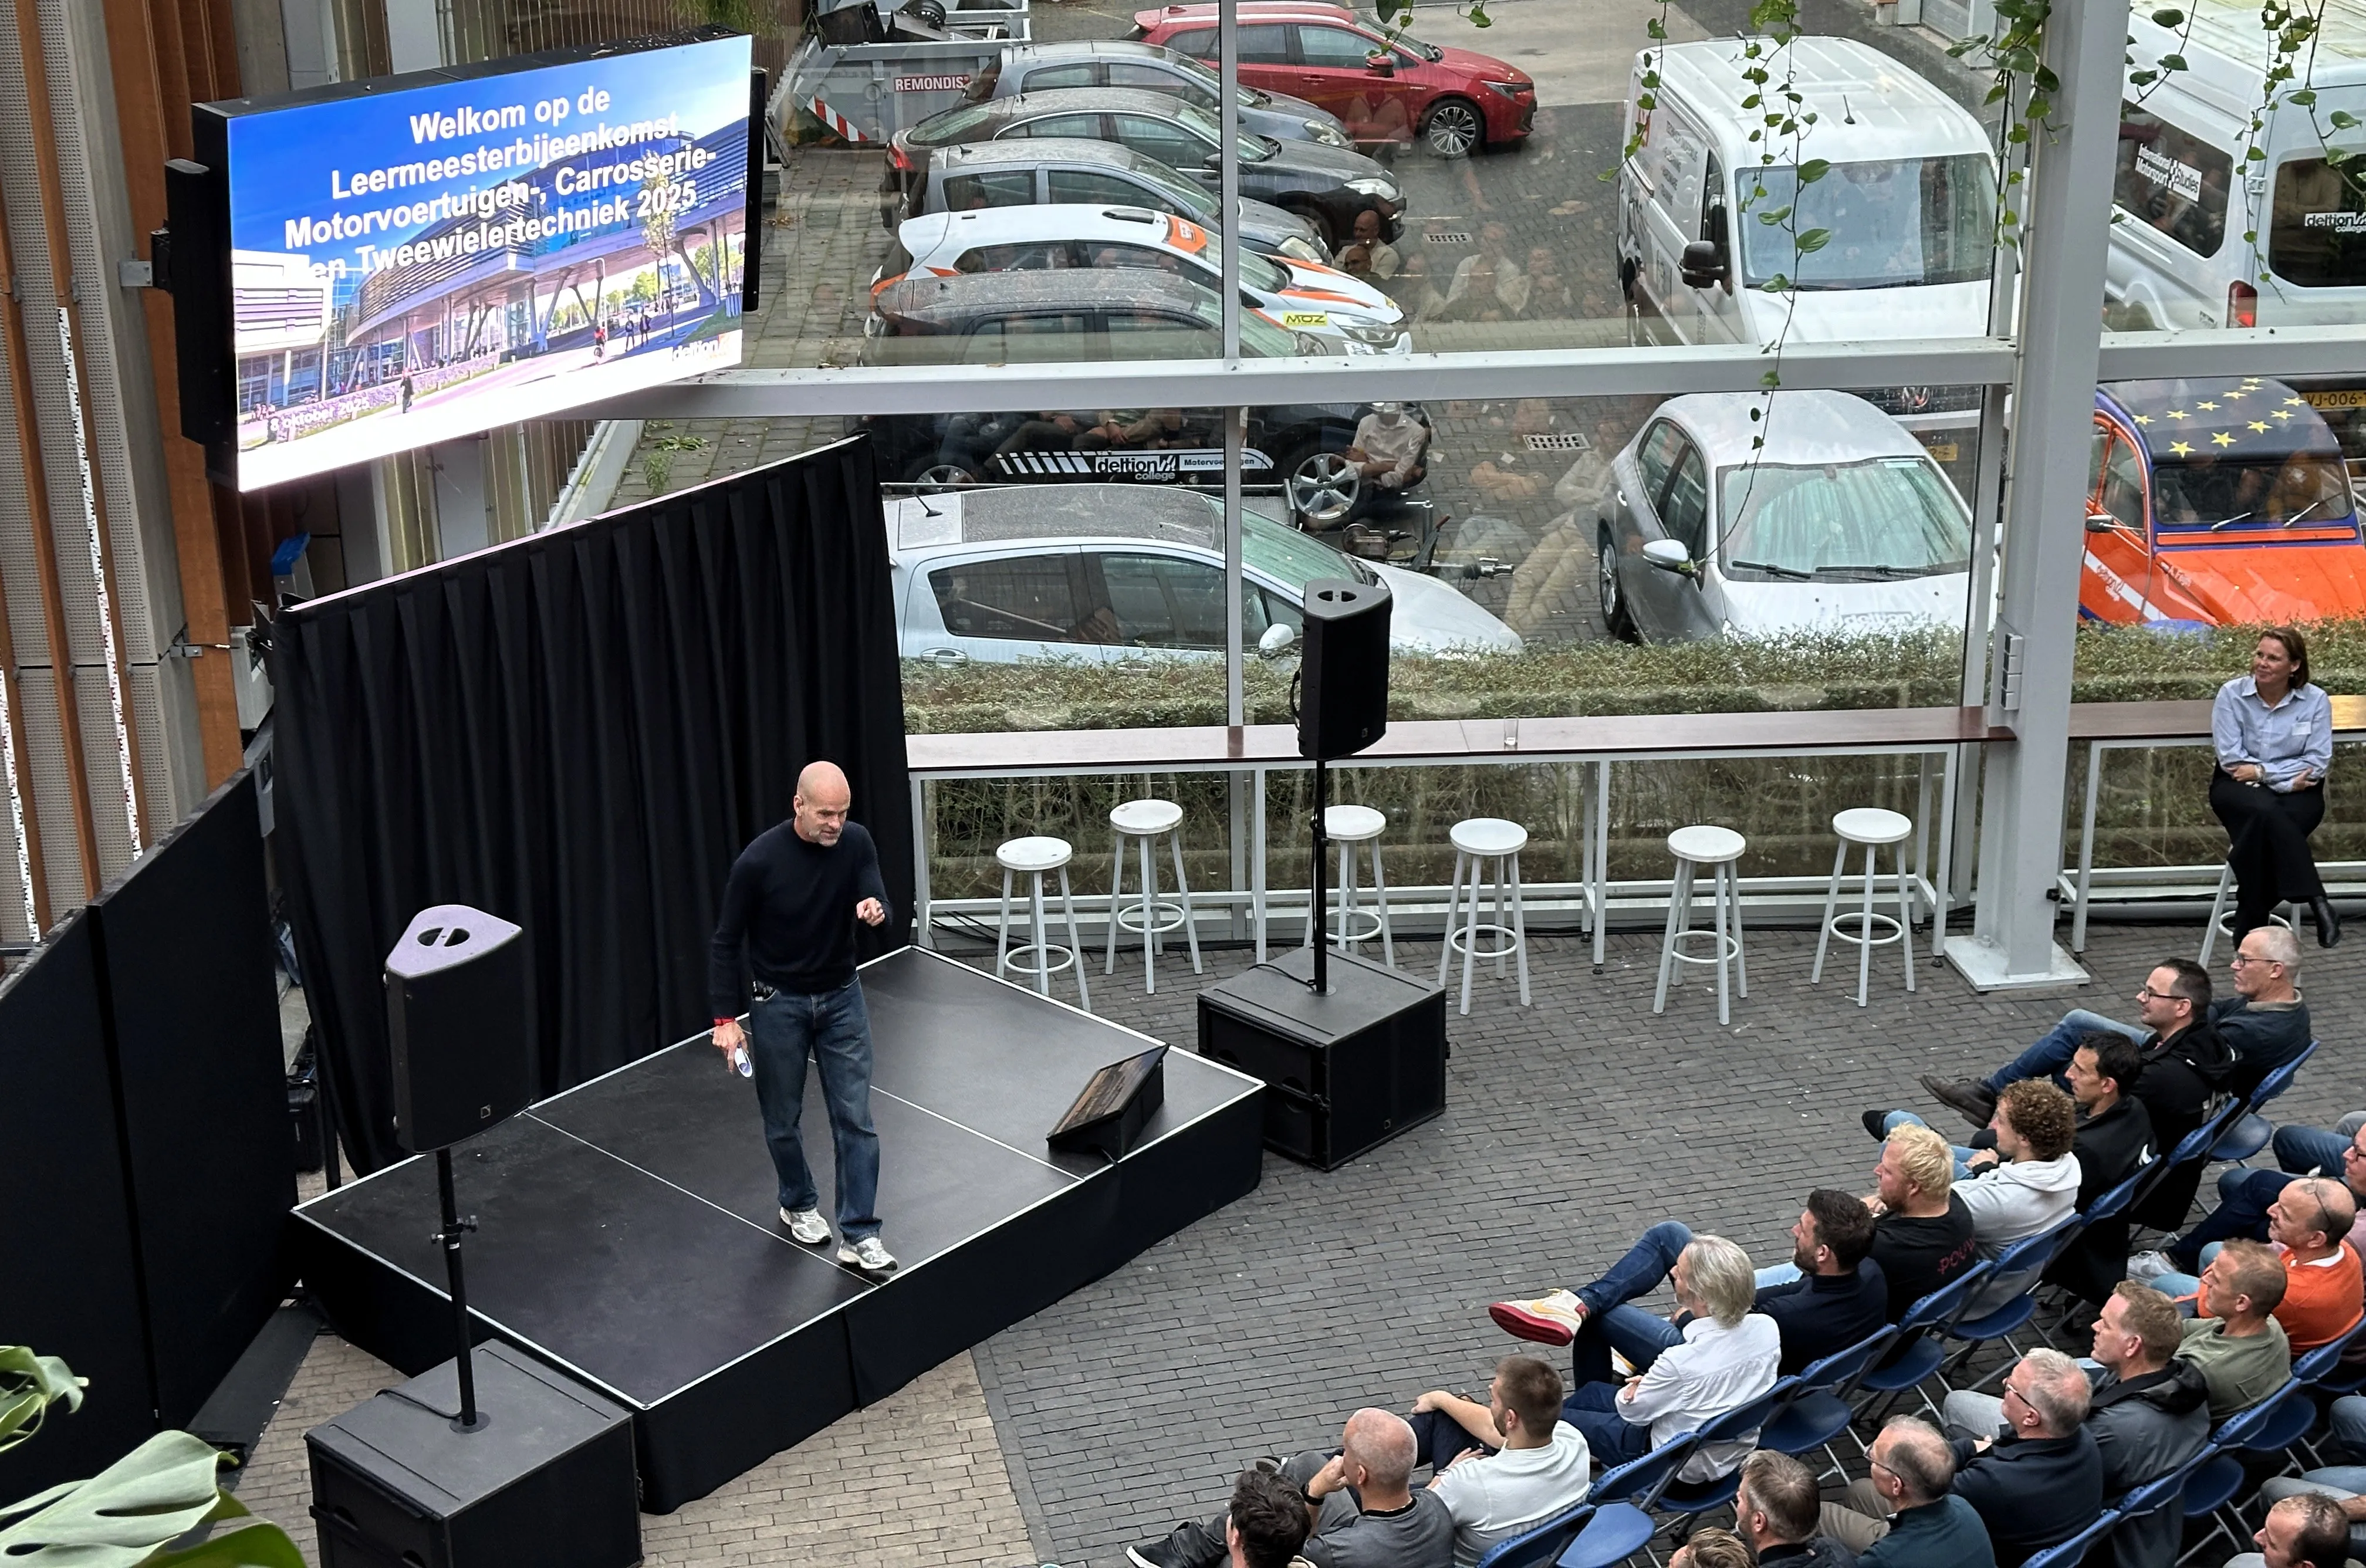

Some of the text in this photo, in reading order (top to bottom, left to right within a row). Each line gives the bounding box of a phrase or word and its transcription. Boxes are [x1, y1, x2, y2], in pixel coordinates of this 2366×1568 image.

[895, 76, 964, 91] REMONDIS
[410, 86, 611, 144] Welkom op de
[332, 110, 679, 200] Leermeesterbijeenkomst
[2135, 157, 2169, 186] Motorsport
[285, 144, 716, 249] Motorvoertuigen-, Carrosserie-
[311, 180, 697, 281] en Tweewielertechniek 2025
[2307, 214, 2354, 227] deltion
[1286, 315, 1326, 323] MOZ
[270, 397, 370, 431] 8 oktober 2025
[1097, 458, 1158, 472] deltion
[1135, 470, 1175, 481] college
